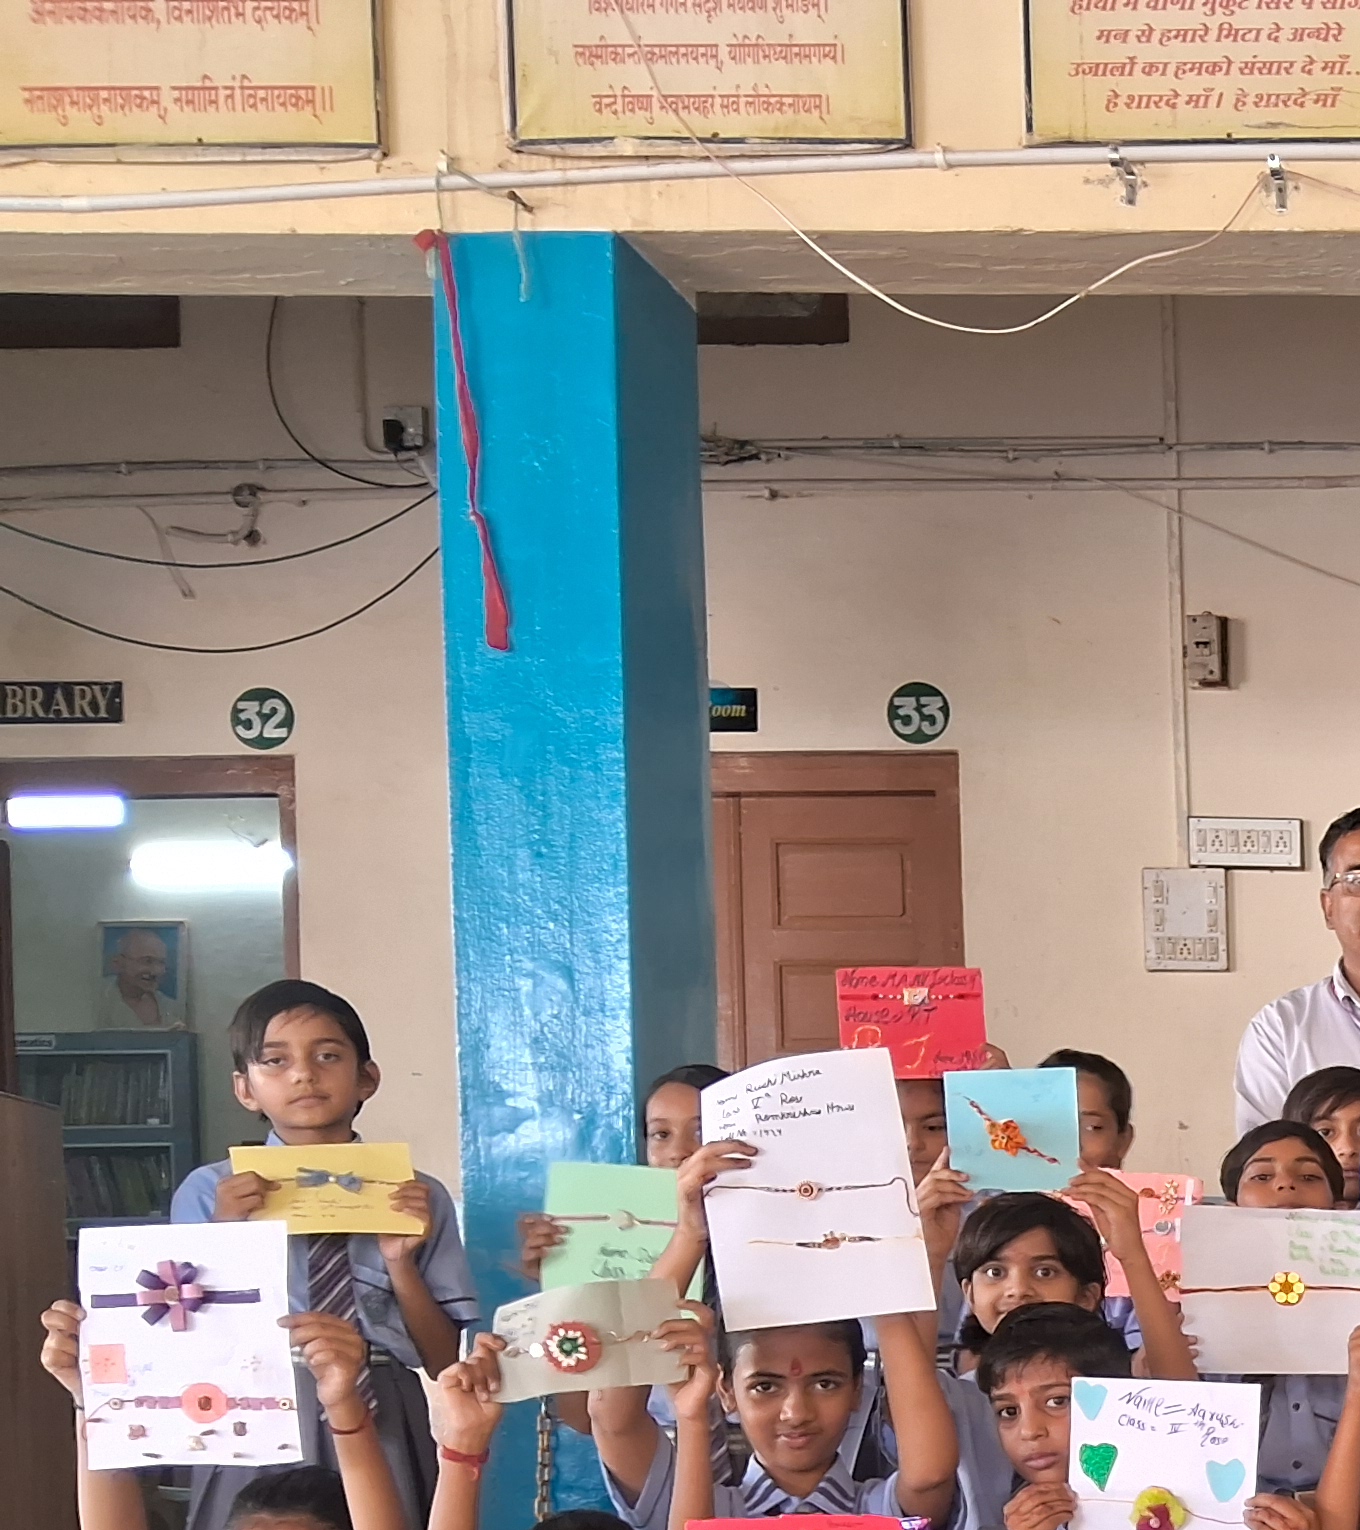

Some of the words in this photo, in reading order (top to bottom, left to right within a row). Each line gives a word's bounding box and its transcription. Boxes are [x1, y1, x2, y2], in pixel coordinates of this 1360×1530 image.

[1096, 26, 1129, 44] मन
[1135, 23, 1154, 44] से
[1159, 23, 1210, 46] हमारे
[1215, 23, 1262, 44] मिटा
[1267, 22, 1284, 44] दे
[1068, 56, 1137, 78] उजालों
[1141, 60, 1168, 78] का
[1175, 56, 1232, 79] हमको
[1239, 55, 1294, 78] संसार
[1300, 56, 1316, 78] दे
[170, 74, 219, 113] नमामि
[222, 74, 236, 113] तं
[239, 74, 318, 125] विनायकम्
[591, 83, 618, 118] वन्दे
[1105, 90, 1120, 112] हे
[1126, 89, 1182, 112] शारदे
[1234, 90, 1249, 112] हे
[1253, 89, 1306, 112] शारदे
[235, 697, 288, 739] 32
[893, 696, 945, 735] 33
